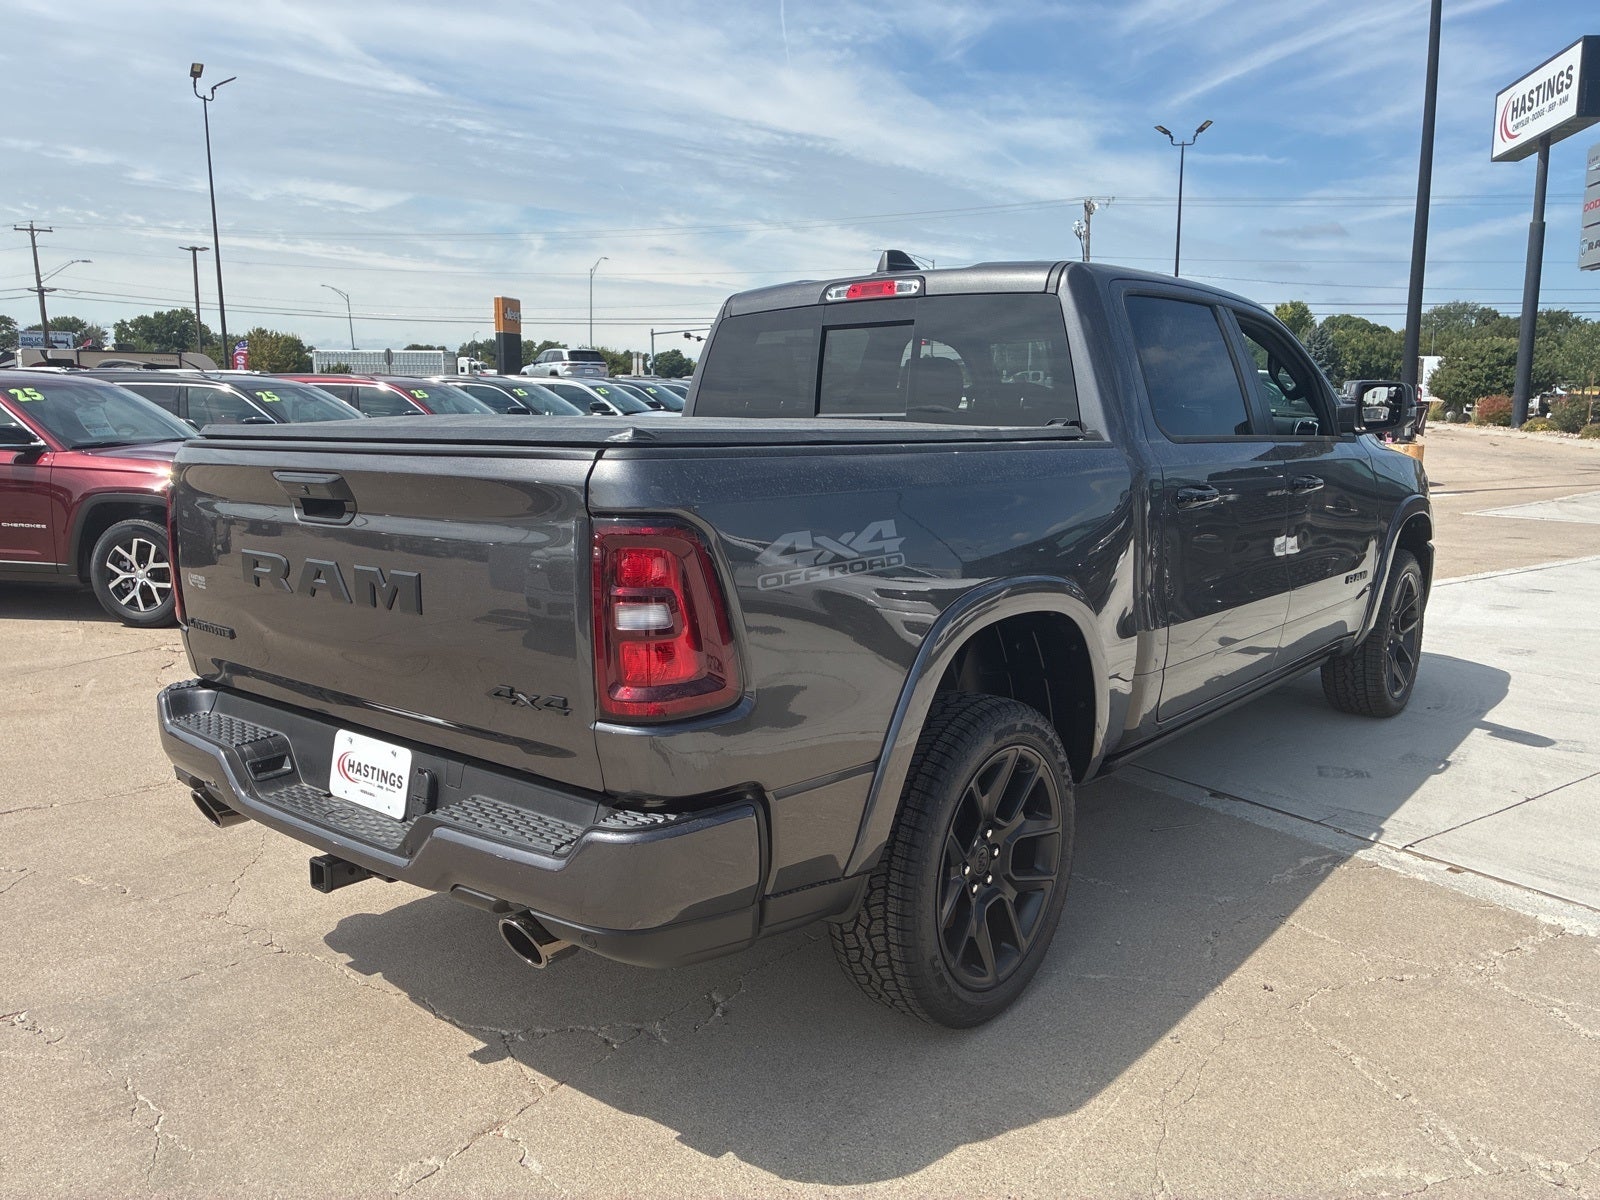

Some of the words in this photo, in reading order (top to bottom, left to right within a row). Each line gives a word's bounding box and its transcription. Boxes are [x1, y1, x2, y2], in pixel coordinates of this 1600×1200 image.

[1511, 64, 1574, 122] HASTINGS
[1512, 116, 1530, 132] CHRYSLER
[1531, 107, 1545, 122] DODGE
[1547, 101, 1557, 113] JEEP
[1559, 94, 1569, 106] RAM
[503, 307, 521, 324] Jeep
[8, 388, 45, 402] 25
[255, 391, 281, 402] 25
[410, 389, 429, 399] 25
[512, 388, 529, 397] 25
[761, 569, 822, 589] OFF
[828, 555, 904, 578] ROAD
[1345, 570, 1368, 584] RAM
[242, 548, 422, 615] RAM
[347, 759, 404, 790] HASTINGS
